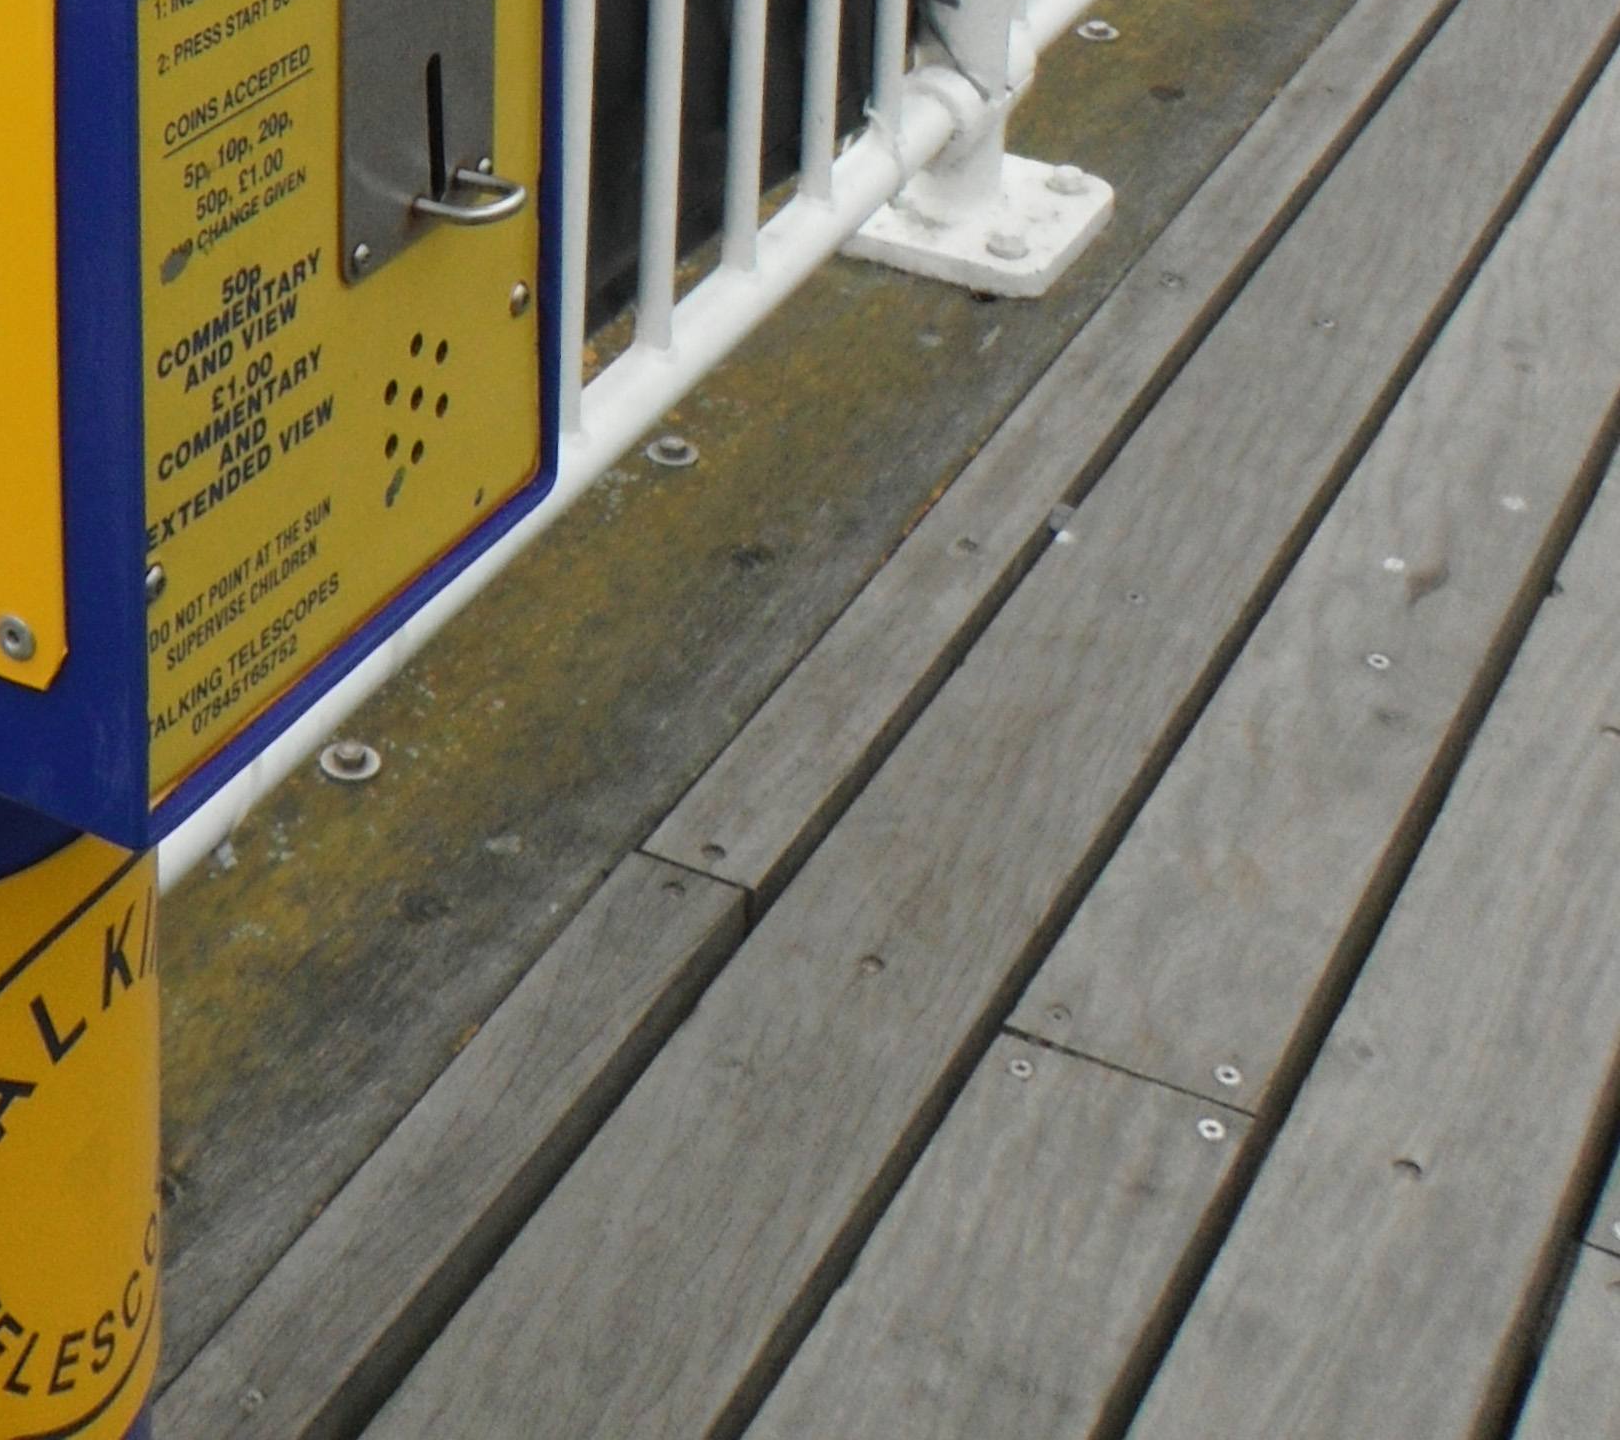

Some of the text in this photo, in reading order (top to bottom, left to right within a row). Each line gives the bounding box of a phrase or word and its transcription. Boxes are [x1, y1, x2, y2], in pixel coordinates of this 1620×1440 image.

[155, 0, 167, 20] 1:
[158, 52, 170, 76] 2:
[174, 20, 222, 65] PRESS
[165, 44, 310, 146] COINS ACCEPTED
[197, 195, 260, 250] CHANGE
[264, 167, 306, 207] GIVEN
[238, 148, 283, 193] £1.00
[157, 247, 321, 379] COMMENTARY
[222, 264, 261, 304] 50p
[184, 294, 298, 394] AND VIEW
[211, 352, 274, 414] £1.00
[158, 344, 323, 481] COMMENTARY
[218, 418, 267, 472] AND
[147, 395, 334, 552] EXTENDED VIEW
[148, 496, 332, 654] DO NOT POINT AT THE SUN
[166, 535, 318, 671] SUPERVISE CHILDREN
[228, 572, 340, 676] TELESCOPES
